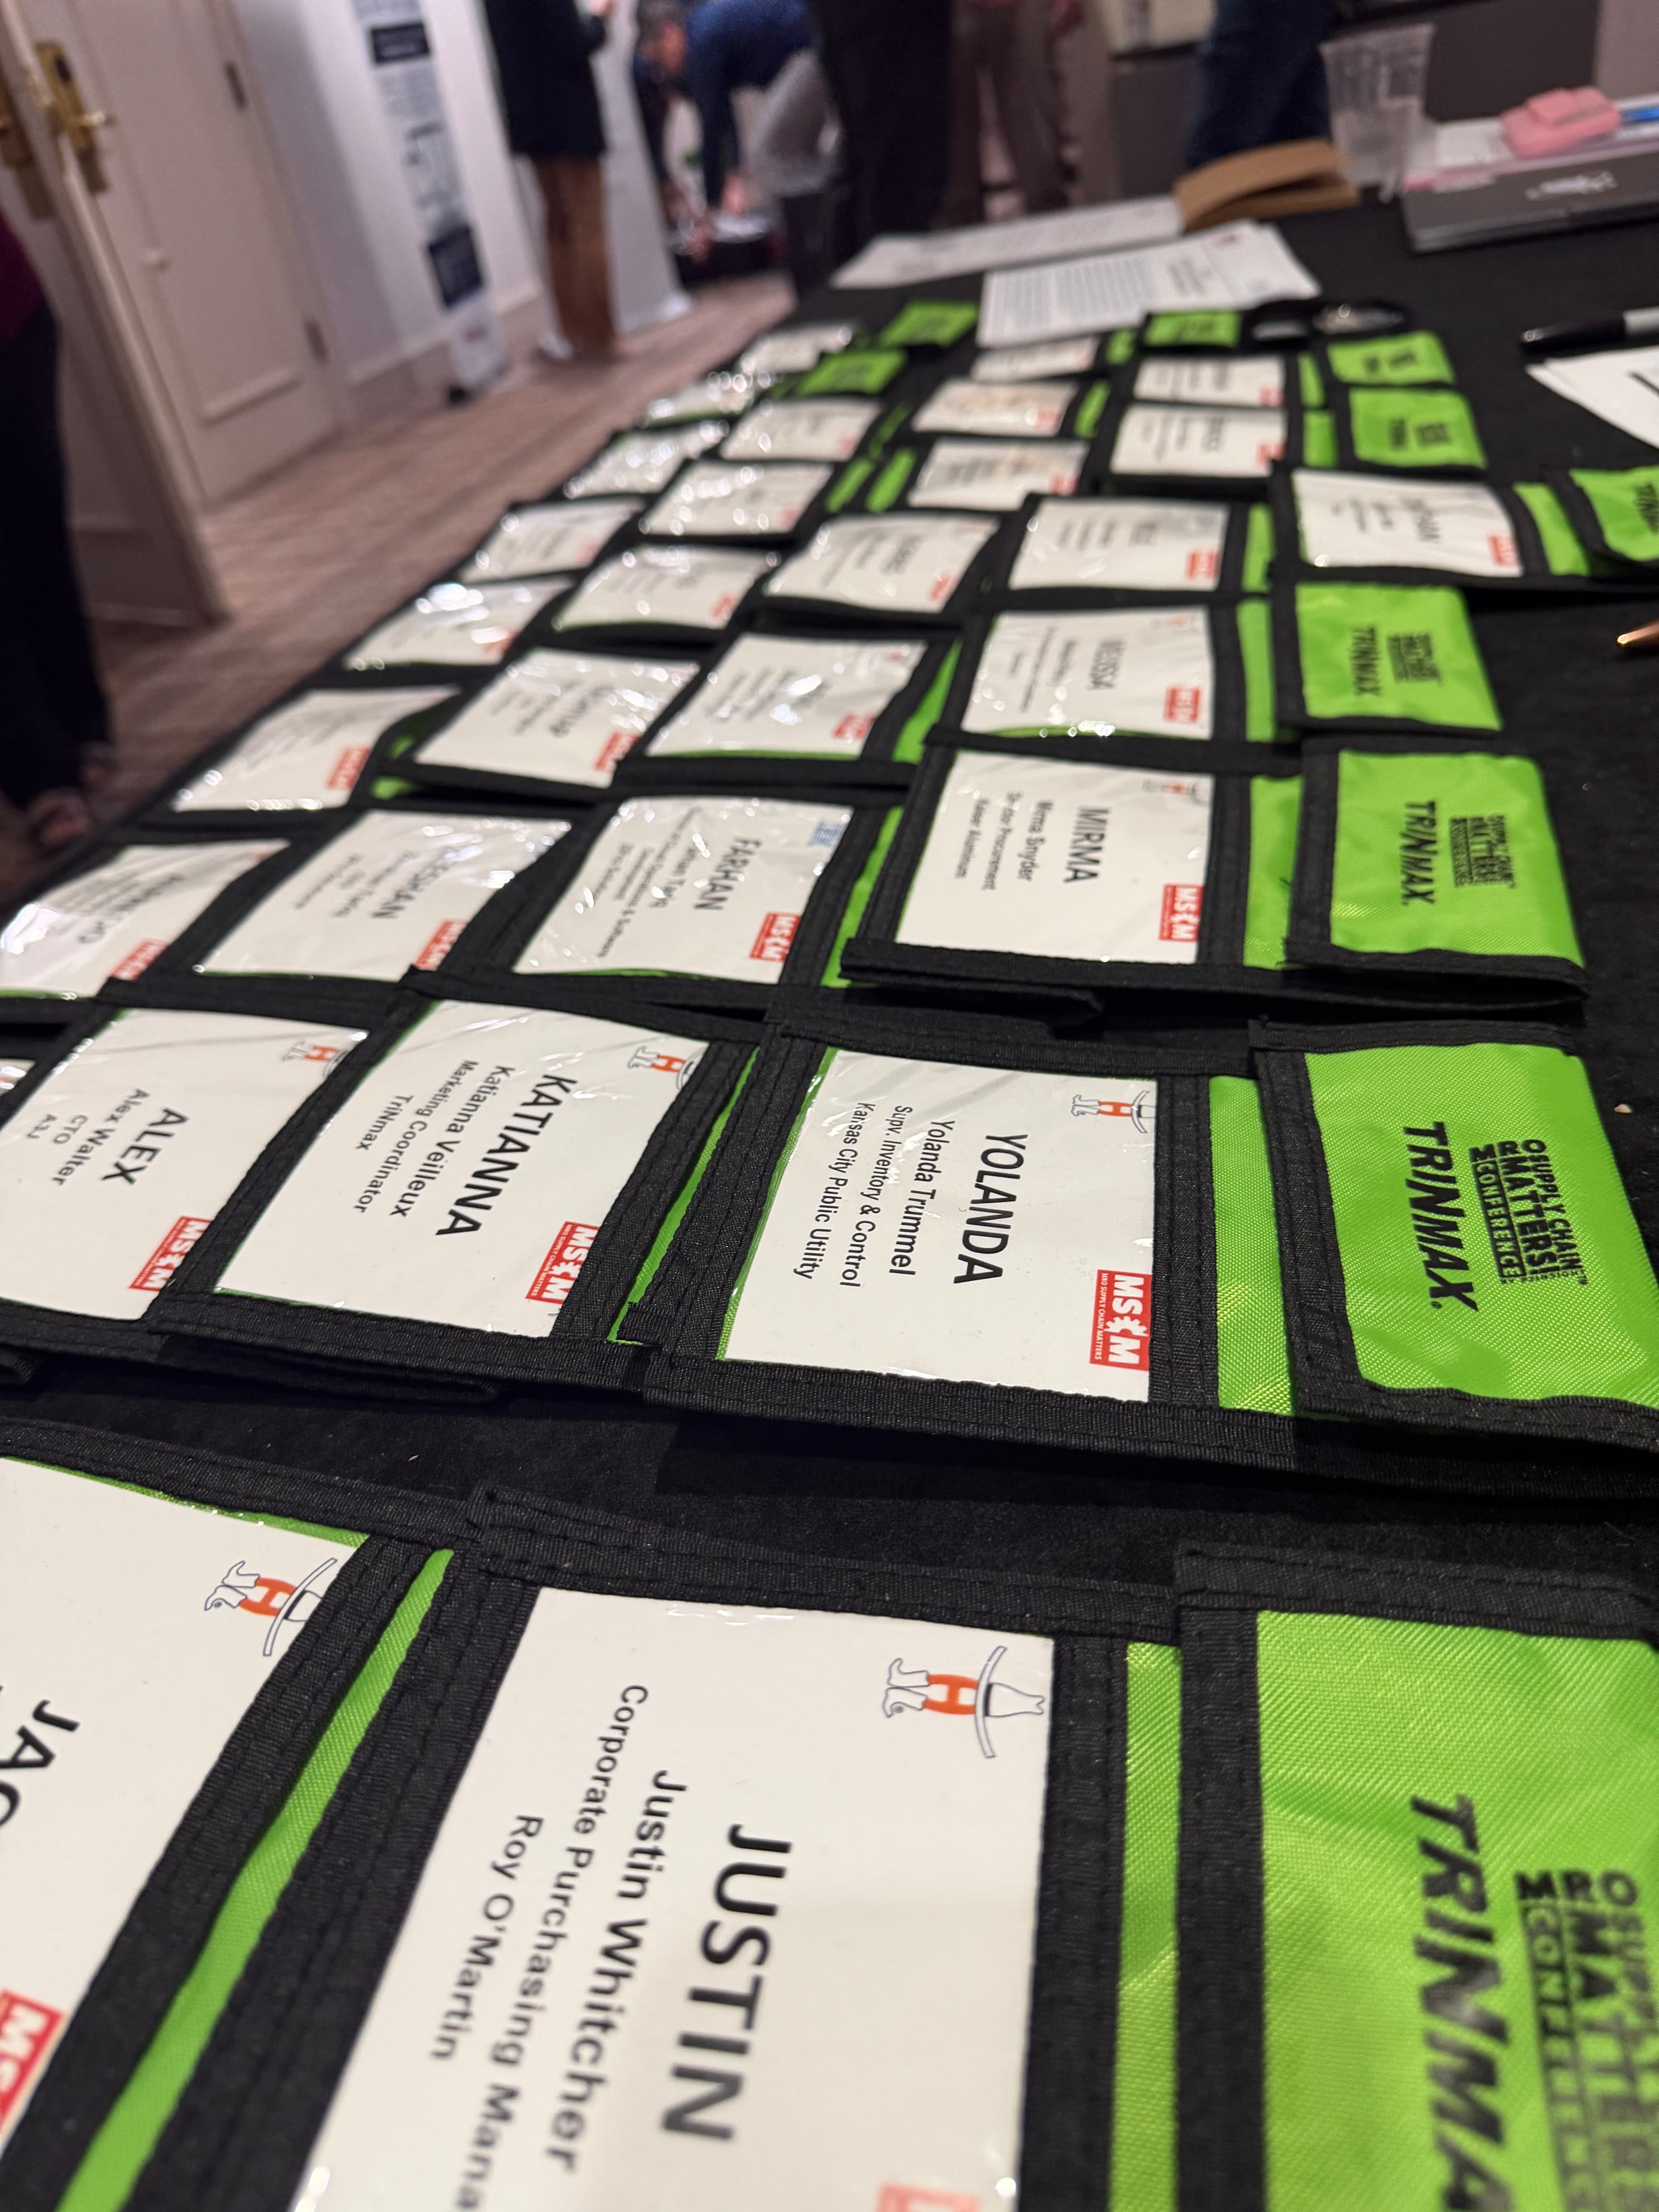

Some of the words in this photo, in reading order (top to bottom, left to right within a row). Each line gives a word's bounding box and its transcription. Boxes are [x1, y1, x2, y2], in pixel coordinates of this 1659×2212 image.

[694, 839, 763, 910] FARHAN
[1017, 837, 1046, 881] Snyder
[1064, 809, 1109, 883] MIRMA
[105, 1088, 147, 1122] Alex
[415, 1060, 479, 1117] Marketing
[445, 1066, 515, 1133] Katianna
[886, 1106, 913, 1136] Supv.
[53, 1115, 88, 1144] CTO
[102, 1108, 188, 1184] ALEX
[356, 1095, 413, 1150] TriNmax
[435, 1074, 577, 1236] KATIANNA
[843, 1103, 876, 1144] Kansas
[914, 1121, 955, 1182] Yolanda
[52, 1128, 115, 1185] Walter
[354, 1121, 427, 1213] Coordinator
[390, 1141, 461, 1217] Veilleux
[828, 1149, 858, 1173] City
[860, 1140, 902, 1201] Inventory
[815, 1177, 849, 1223] Public
[859, 1205, 881, 1215] &
[889, 1189, 937, 1275] Trummel
[953, 1135, 1028, 1284] YOLANDA
[1475, 1163, 1521, 1278] CONFERENCE
[1499, 1156, 1560, 1275] MATTERS!
[1529, 1155, 1566, 1214] SUPPLY
[1548, 1218, 1584, 1270] CHAIN
[793, 1228, 832, 1279] Utility
[839, 1220, 876, 1287] Control
[1096, 1309, 1106, 1329] CHAIN
[1099, 1286, 1108, 1309] SUPPLY
[1094, 1330, 1104, 1360] MATTERS
[574, 1685, 648, 1834] Corporate
[491, 1815, 544, 1879] Roy
[617, 1770, 686, 1899] Justin
[432, 1894, 514, 2059] O'Martin
[491, 1847, 594, 2066] Purchasing
[661, 1824, 791, 2141] JUSTIN
[1411, 1794, 1516, 2212] TRINMA
[549, 1919, 647, 2168] Whitcher
[455, 2084, 521, 2211] Mana
